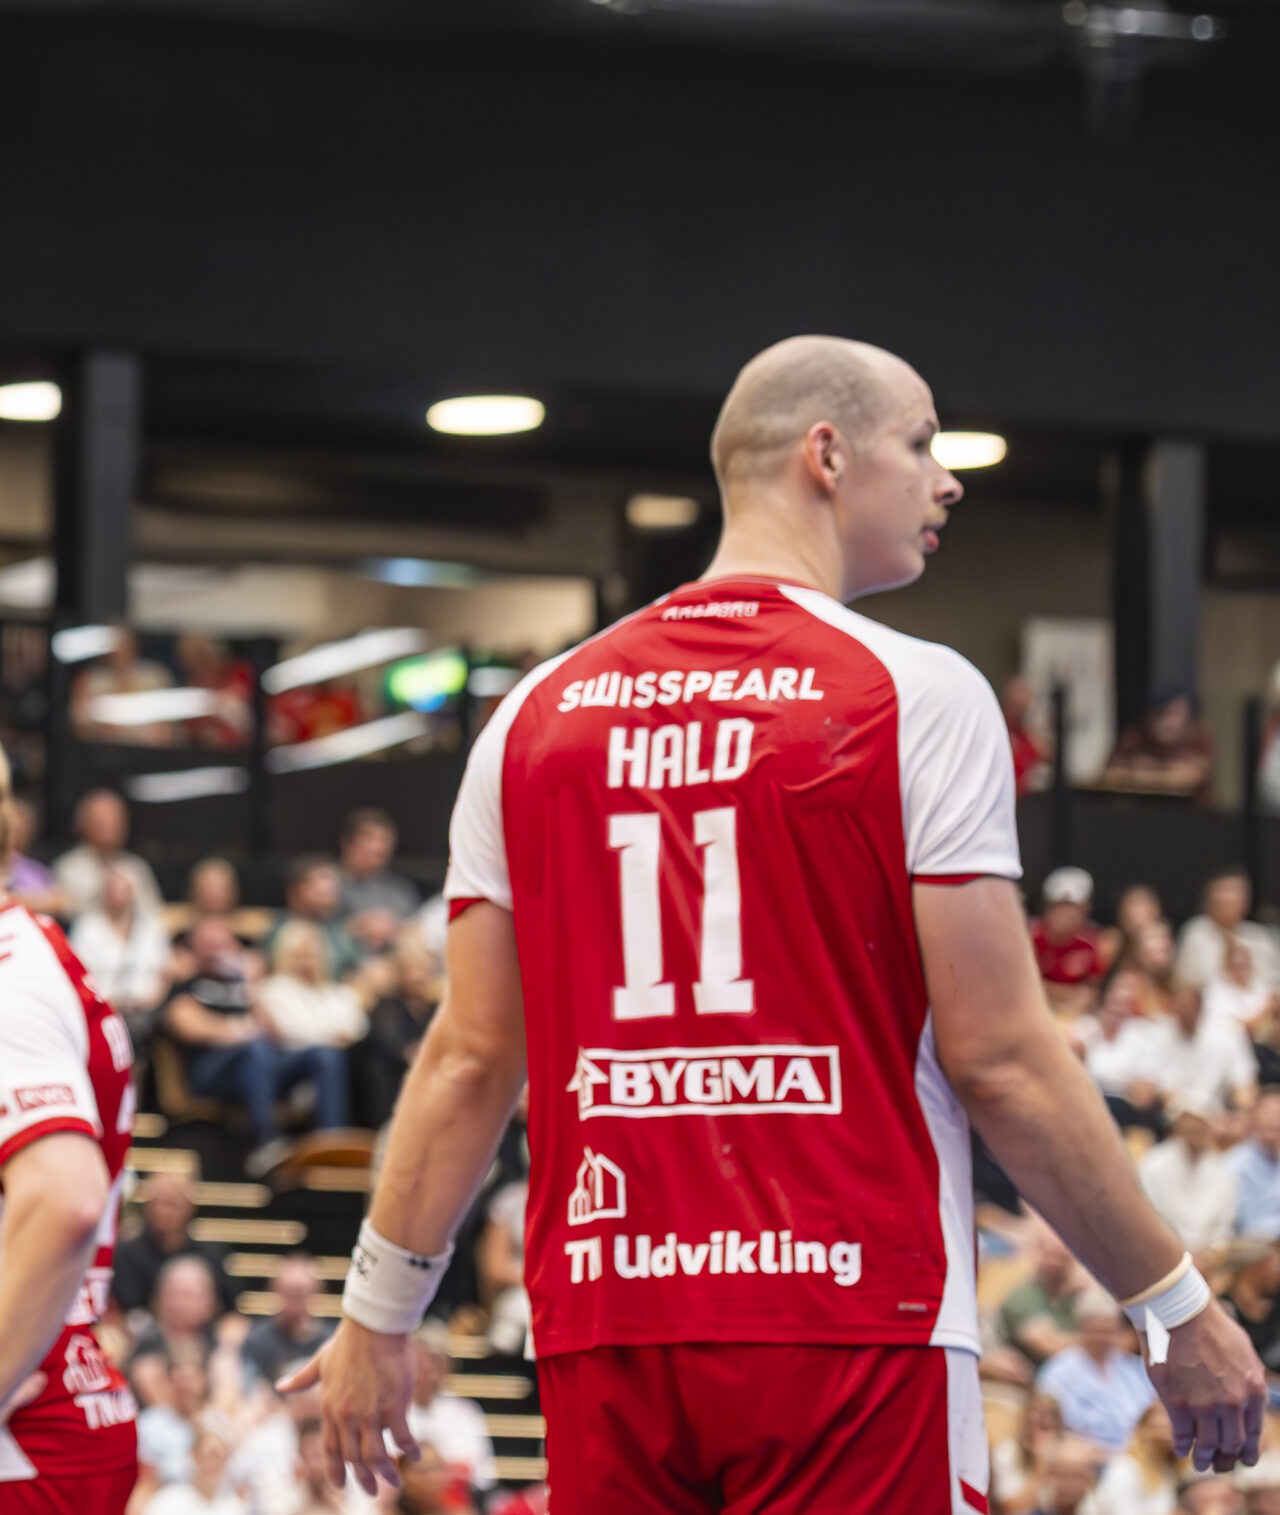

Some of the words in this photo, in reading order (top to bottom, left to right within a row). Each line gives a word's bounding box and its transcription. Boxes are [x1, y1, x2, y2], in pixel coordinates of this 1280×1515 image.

[557, 667, 825, 713] SWISSPEARL
[607, 717, 755, 790] HALD
[607, 806, 756, 1020] 11
[609, 1057, 825, 1105] BYGMA
[614, 1229, 862, 1287] Udvikling
